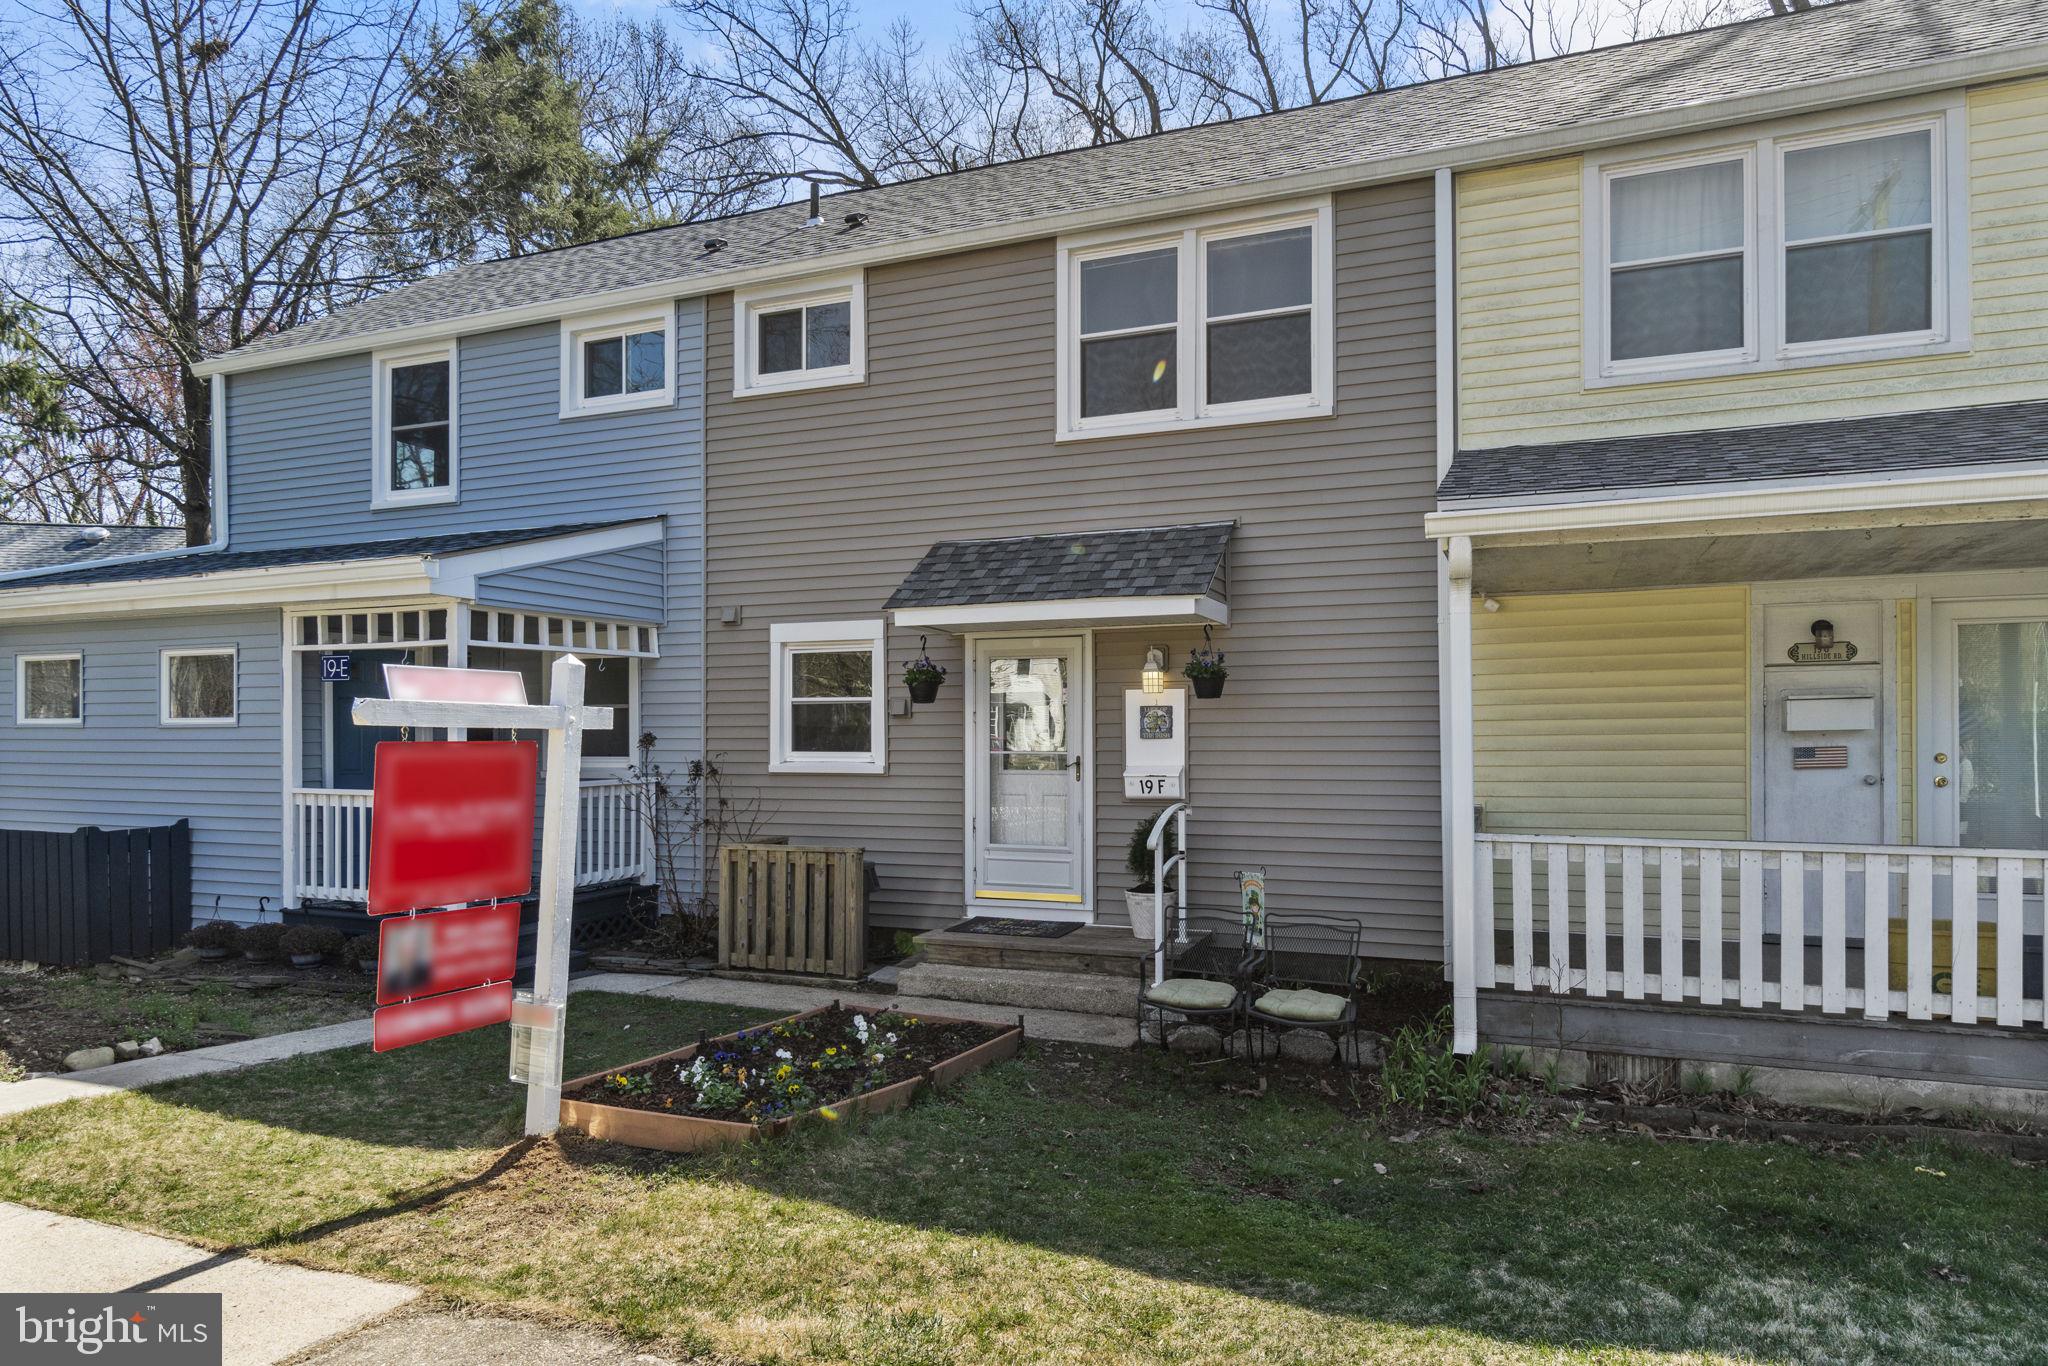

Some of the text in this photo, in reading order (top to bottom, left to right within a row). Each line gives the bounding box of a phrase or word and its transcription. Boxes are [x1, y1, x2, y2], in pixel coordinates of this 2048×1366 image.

[323, 659, 348, 677] 19-E
[1139, 779, 1165, 794] 19 F
